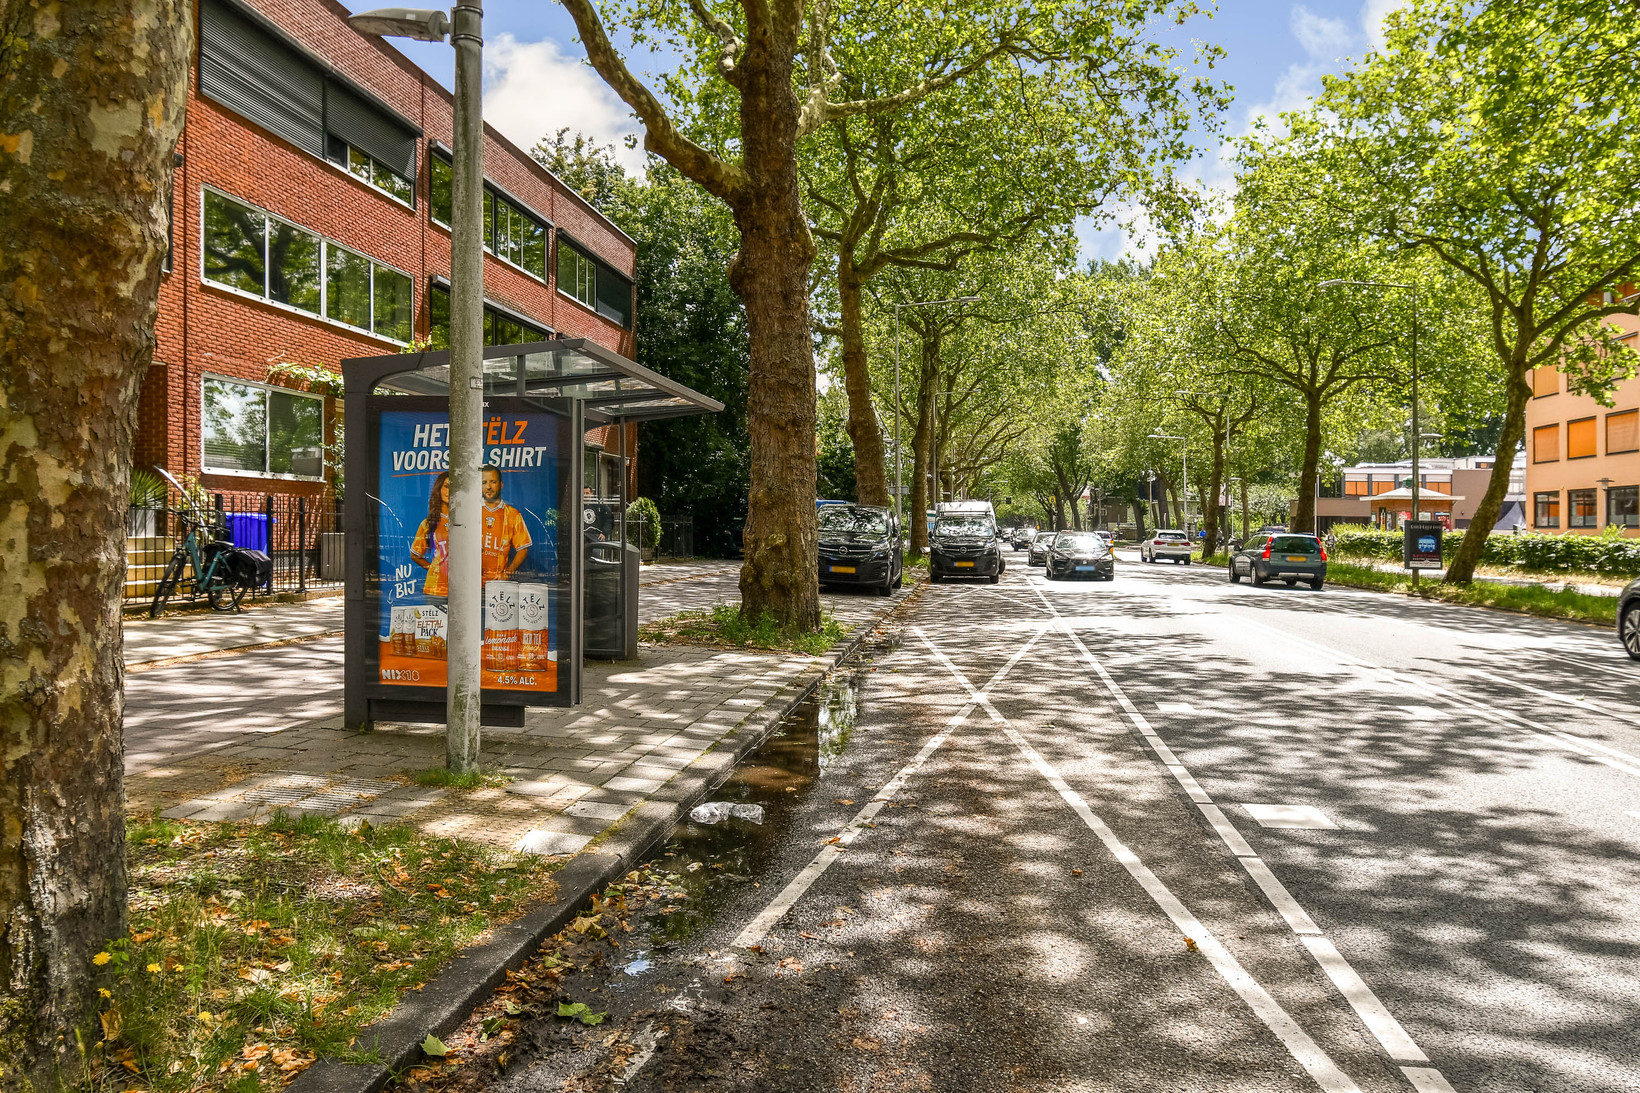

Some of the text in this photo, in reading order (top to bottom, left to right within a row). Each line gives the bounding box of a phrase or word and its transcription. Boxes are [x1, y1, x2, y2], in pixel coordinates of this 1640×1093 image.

[482, 416, 528, 445] ËLZ
[395, 563, 412, 581] NU
[394, 579, 417, 599] BIJ
[489, 591, 515, 610] STËLZ
[520, 593, 545, 611] STËLZ
[420, 628, 439, 637] PACK
[381, 669, 420, 681] NIX18
[497, 676, 537, 686] 4.5% ALC.
